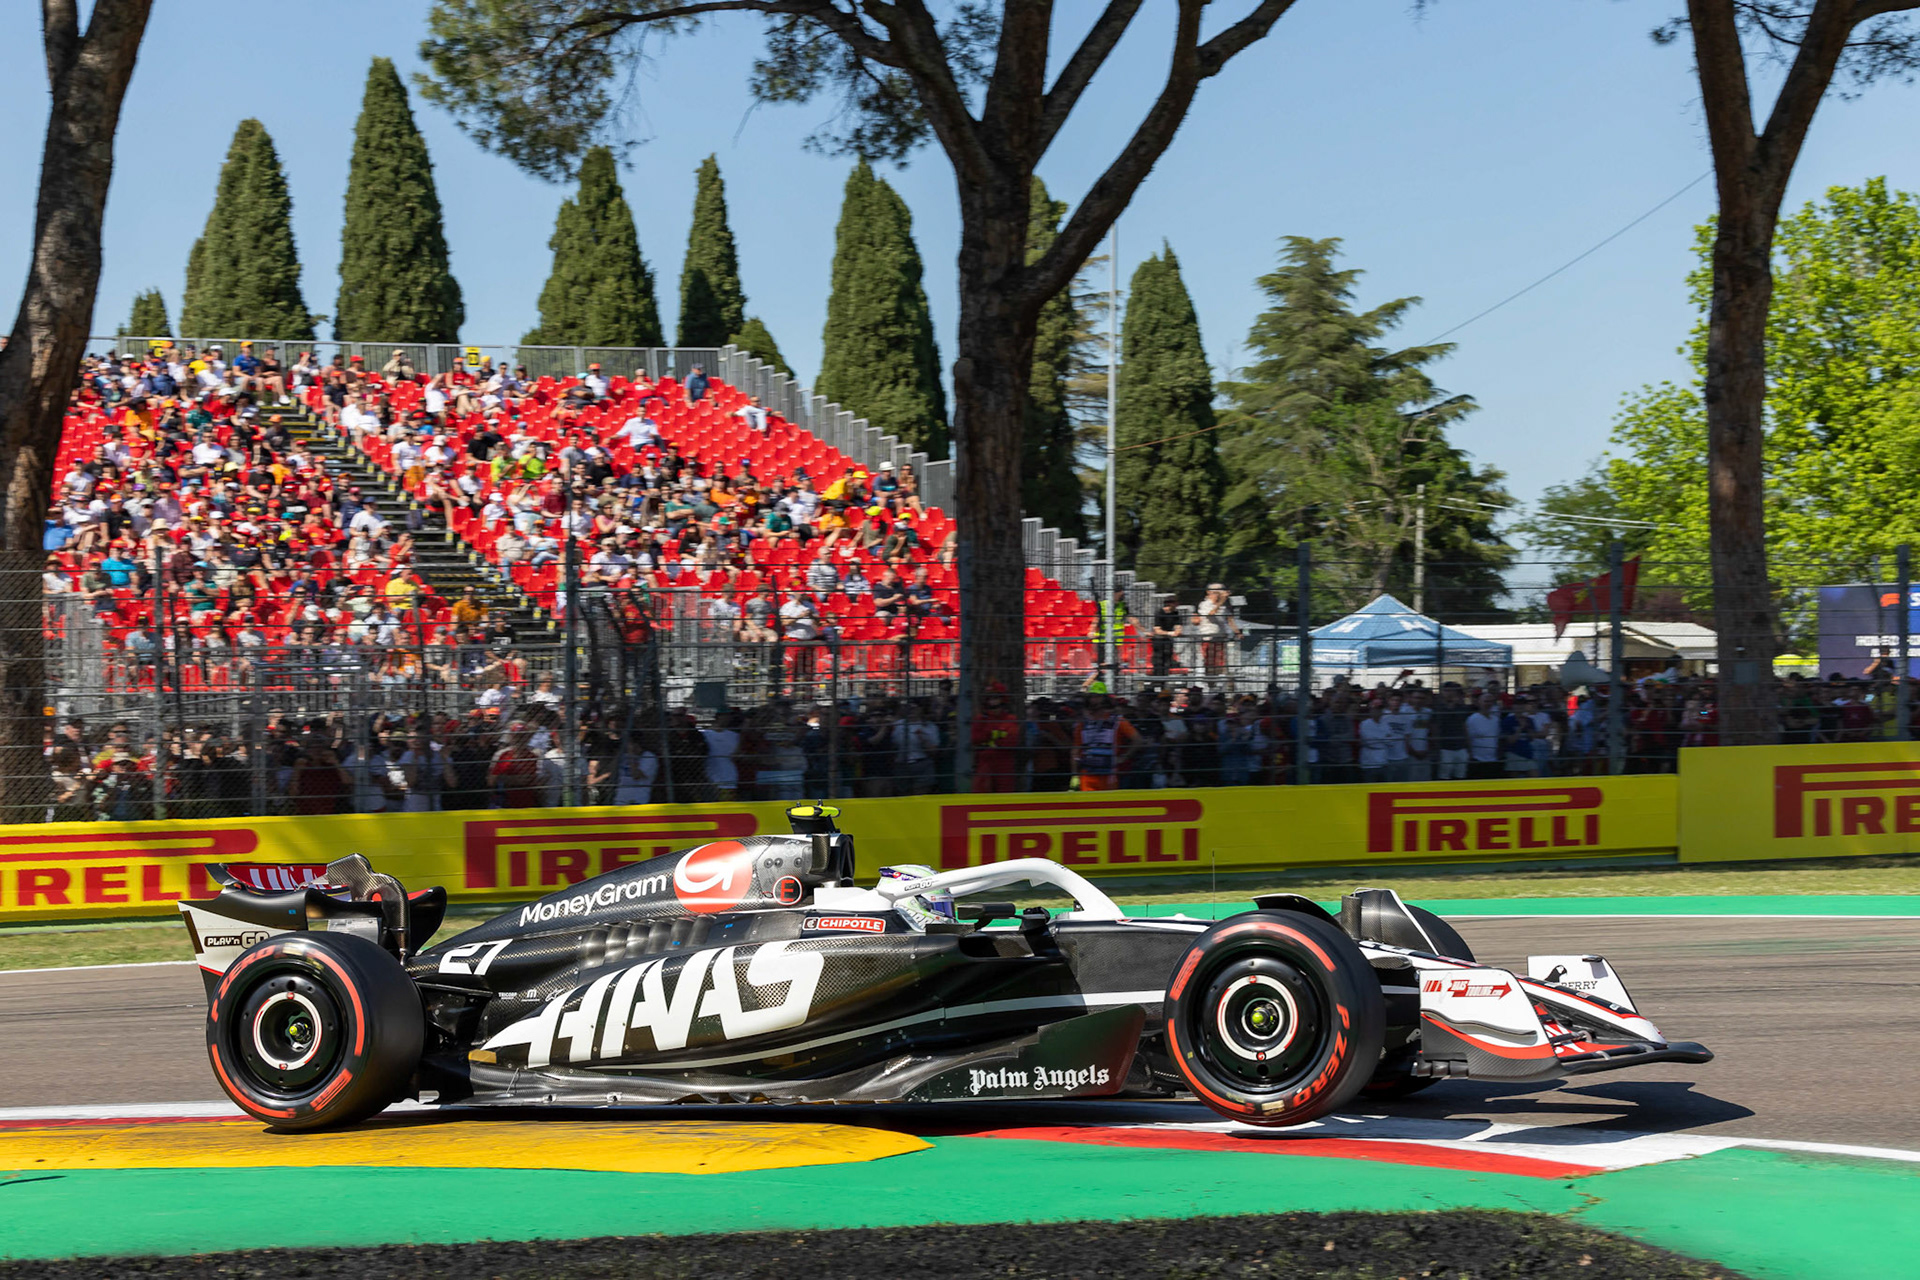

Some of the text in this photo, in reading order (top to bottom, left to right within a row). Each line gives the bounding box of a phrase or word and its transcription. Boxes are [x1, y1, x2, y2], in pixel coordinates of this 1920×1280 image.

[940, 800, 1203, 868] PIRELLI
[1368, 787, 1603, 853] PIRELLI
[519, 874, 667, 927] MoneyGram
[780, 879, 795, 902] E
[820, 919, 882, 930] CHIPOTLE
[438, 938, 513, 976] 27
[480, 940, 825, 1068] HAAS
[969, 1064, 1110, 1095] Palm Angels
[1293, 1003, 1350, 1108] P ZERO
